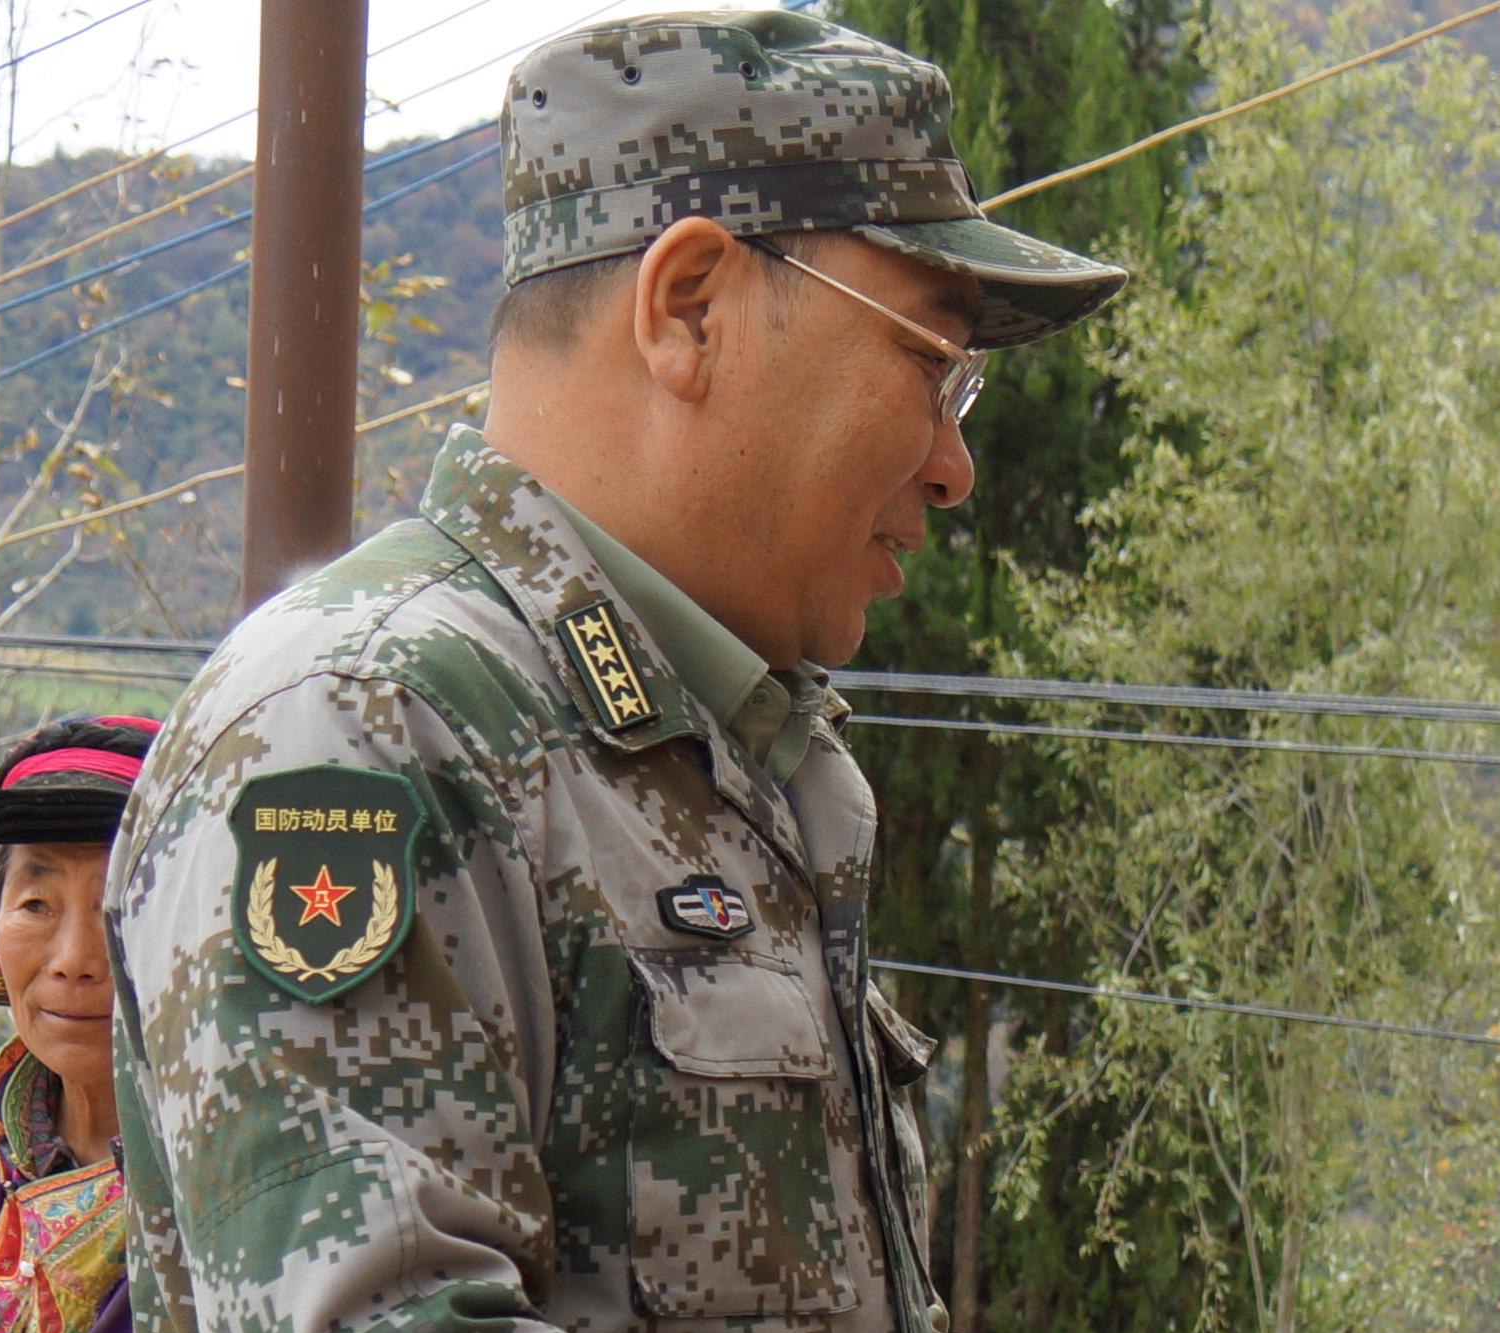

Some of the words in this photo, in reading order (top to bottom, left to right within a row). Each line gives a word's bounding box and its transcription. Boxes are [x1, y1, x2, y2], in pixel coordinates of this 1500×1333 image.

[255, 808, 397, 833] 国防动员单位
